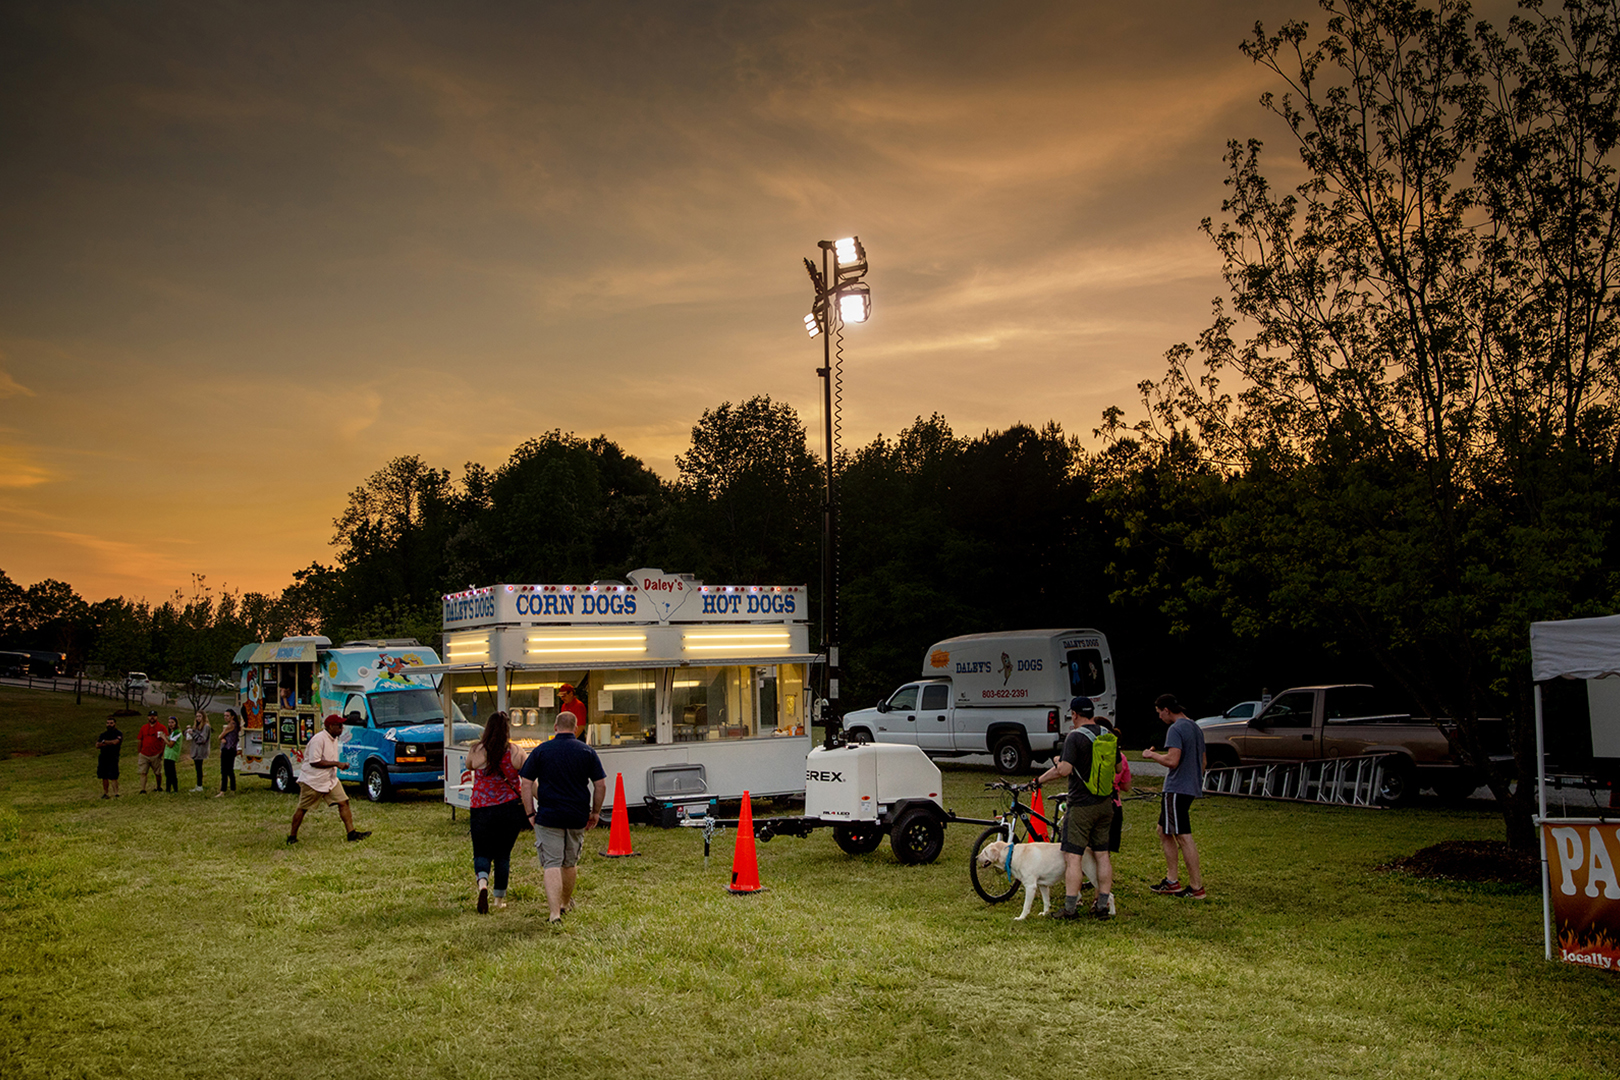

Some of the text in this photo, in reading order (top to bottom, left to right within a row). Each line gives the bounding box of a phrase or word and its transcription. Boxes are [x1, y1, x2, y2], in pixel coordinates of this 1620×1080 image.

[644, 578, 683, 592] Daley's
[446, 595, 495, 622] DALEY'S DOGS
[516, 594, 637, 615] CORN DOGS
[702, 594, 796, 614] HOT DOGS
[1063, 638, 1100, 649] DALEY'S DOGS
[956, 659, 1043, 674] DALEY'S DOGS
[982, 689, 1029, 698] 803-622-2391
[1551, 826, 1620, 900] PA
[1562, 949, 1612, 968] locally
